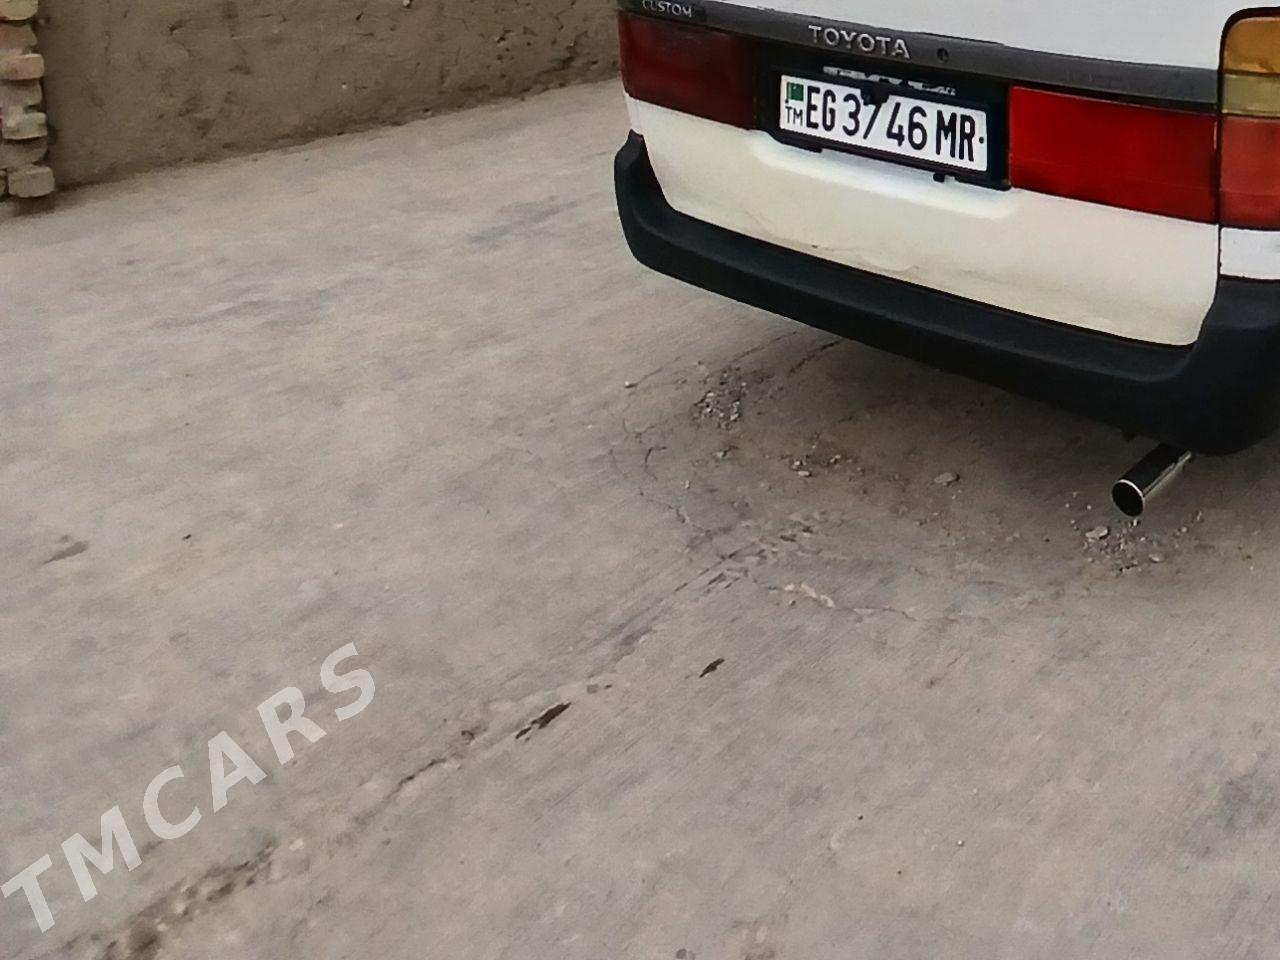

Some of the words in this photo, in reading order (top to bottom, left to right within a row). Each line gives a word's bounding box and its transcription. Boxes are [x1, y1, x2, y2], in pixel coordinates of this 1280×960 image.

[642, 0, 693, 18] CUSTOM
[808, 25, 911, 60] TOYOTA
[785, 106, 804, 126] TM
[935, 109, 976, 162] MR
